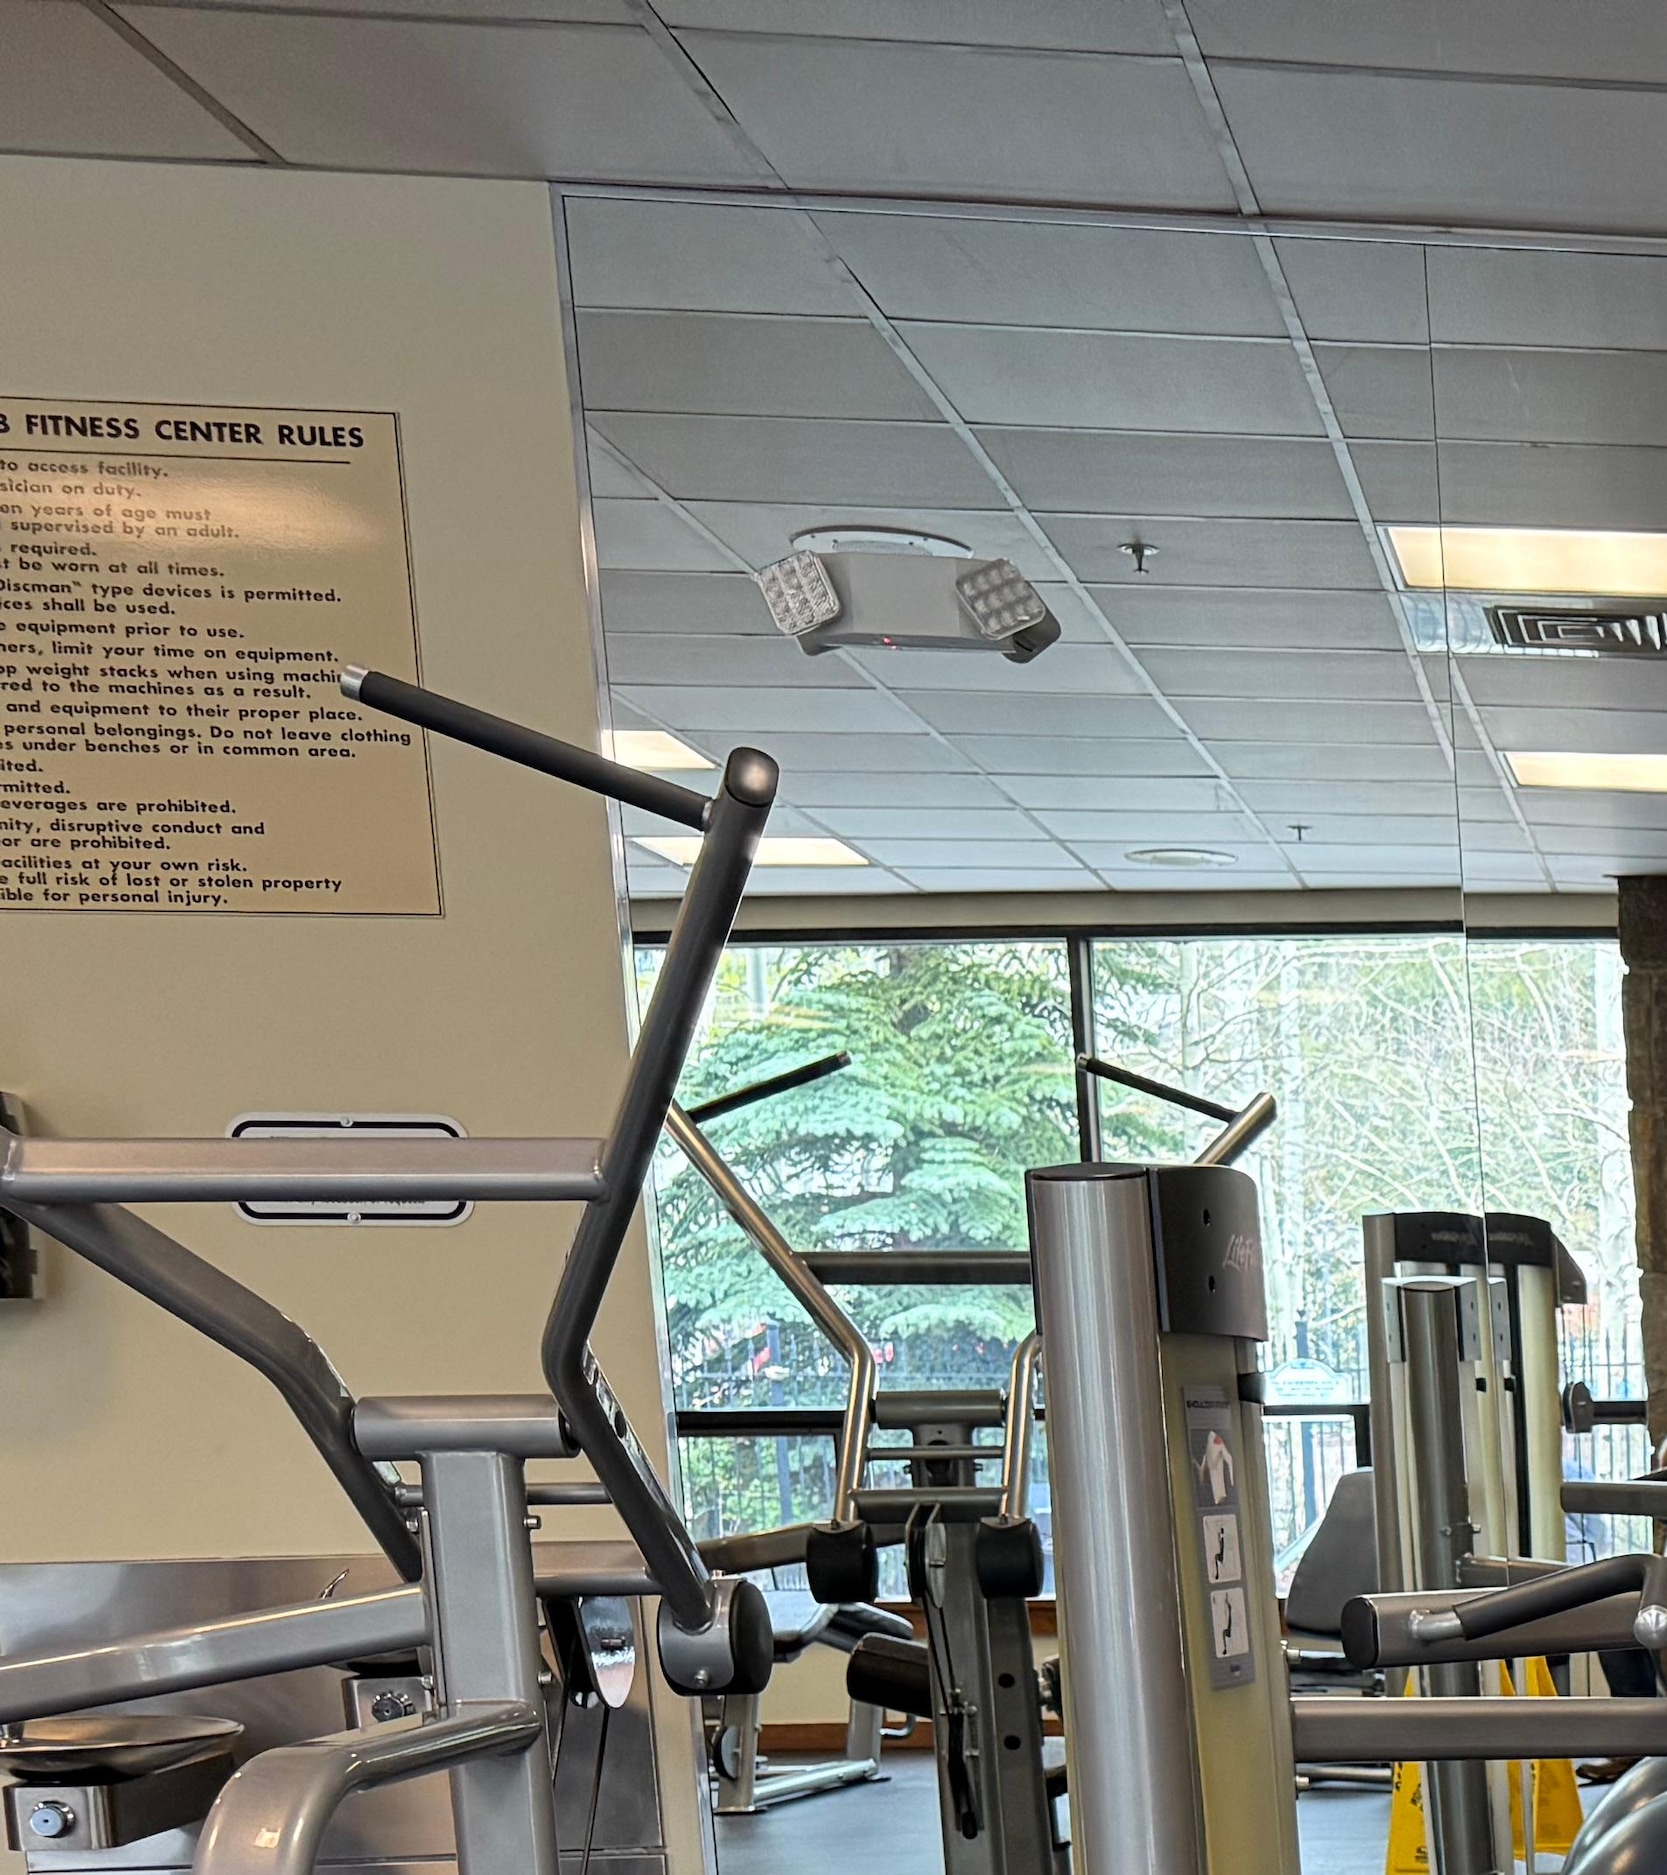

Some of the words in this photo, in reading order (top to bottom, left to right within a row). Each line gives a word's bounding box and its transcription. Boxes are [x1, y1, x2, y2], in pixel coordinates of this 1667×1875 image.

[25, 414, 139, 439] FITNESS
[155, 420, 263, 444] CENTER
[278, 424, 364, 448] RULES
[28, 462, 88, 474] access
[98, 461, 168, 480] facility.
[61, 485, 85, 495] on
[93, 481, 141, 500] duty.
[30, 504, 84, 518] years
[93, 504, 112, 517] of
[121, 508, 156, 522] age
[165, 509, 211, 521] must
[11, 519, 114, 535] supervised
[122, 521, 145, 539] by
[154, 526, 177, 536] an
[186, 524, 239, 538] adult.
[11, 541, 97, 557] required.
[19, 556, 42, 571] be
[51, 562, 99, 573] worn
[108, 562, 127, 573] at
[137, 561, 159, 574] all
[168, 562, 224, 577] times.
[91, 583, 133, 598] type
[142, 583, 212, 598] devices
[221, 585, 235, 599] is
[244, 588, 341, 603] permitted.
[43, 597, 85, 612] shall
[93, 599, 117, 613] be
[126, 601, 175, 615] used.
[16, 619, 115, 636] equipment
[125, 622, 170, 638] prior
[179, 625, 197, 636] to
[206, 628, 244, 638] use.
[52, 641, 93, 655] limit
[102, 647, 145, 659] your
[153, 644, 194, 658] time
[204, 649, 226, 659] on
[235, 647, 338, 664] equipment.
[26, 662, 89, 680] weight
[100, 665, 158, 678] stacks
[167, 665, 217, 680] when
[226, 667, 274, 685] using
[42, 680, 60, 692] to
[69, 679, 100, 693] the
[108, 681, 194, 695] machines
[204, 687, 224, 696] as
[233, 688, 244, 697] a
[253, 684, 311, 698] result.
[6, 700, 41, 713] and
[50, 701, 150, 718] equipment
[158, 705, 177, 716] to
[186, 703, 230, 717] their
[238, 709, 300, 722] proper
[309, 707, 362, 723] place.
[4, 722, 85, 737] personal
[94, 722, 201, 741] belongings.
[210, 726, 234, 738] Do
[243, 728, 273, 739] not
[281, 727, 331, 741] leave
[341, 728, 411, 746] clothing
[22, 737, 76, 752] under
[84, 739, 160, 753] benches
[170, 745, 189, 754] or
[197, 741, 214, 754] in
[223, 746, 299, 756] common
[308, 748, 355, 758] area.
[97, 802, 127, 811] are
[136, 799, 236, 815] prohibited.
[50, 818, 142, 836] disruptive
[152, 820, 222, 834] conduct
[231, 822, 265, 835] and
[30, 838, 61, 848] are
[70, 835, 170, 851] prohibited.
[81, 858, 100, 869] at
[109, 861, 151, 874] your
[160, 862, 199, 871] own
[208, 858, 247, 872] risk.
[18, 871, 47, 885] full
[56, 872, 90, 886] risk
[99, 871, 117, 886] of
[126, 873, 160, 887] lost
[169, 878, 188, 887] or
[198, 874, 253, 888] stolen
[262, 878, 342, 892] property
[43, 888, 70, 902] for
[79, 889, 159, 905] personal
[168, 890, 227, 907] injury.
